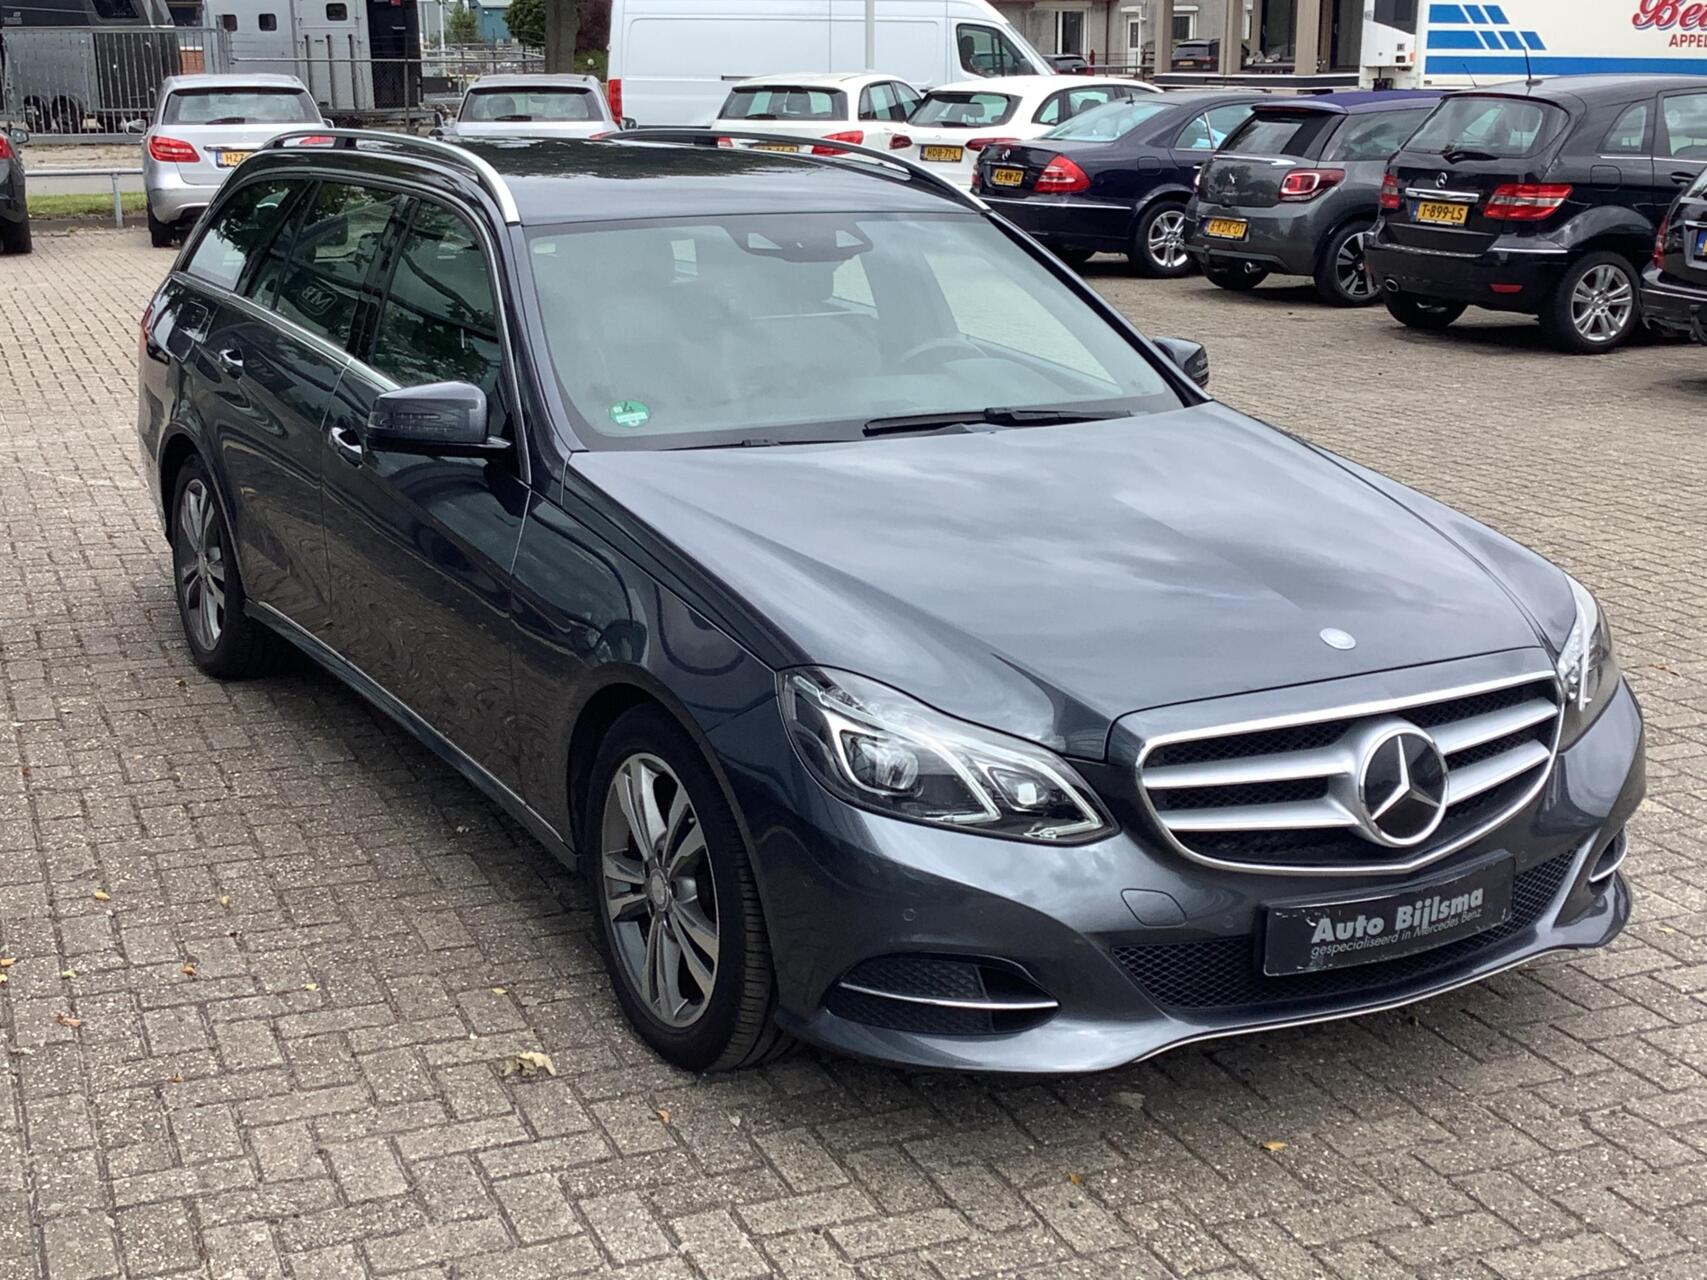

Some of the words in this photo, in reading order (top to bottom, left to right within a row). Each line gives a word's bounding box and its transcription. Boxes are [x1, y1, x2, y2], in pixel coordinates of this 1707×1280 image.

[1421, 203, 1465, 221] T-899-LS
[1310, 930, 1401, 960] gespecialiseerd
[1401, 929, 1412, 941] in
[1413, 914, 1460, 938] Mercedes
[1461, 909, 1483, 924] Benz
[1311, 914, 1385, 943] Auto
[1395, 888, 1484, 931] Bijlsma
